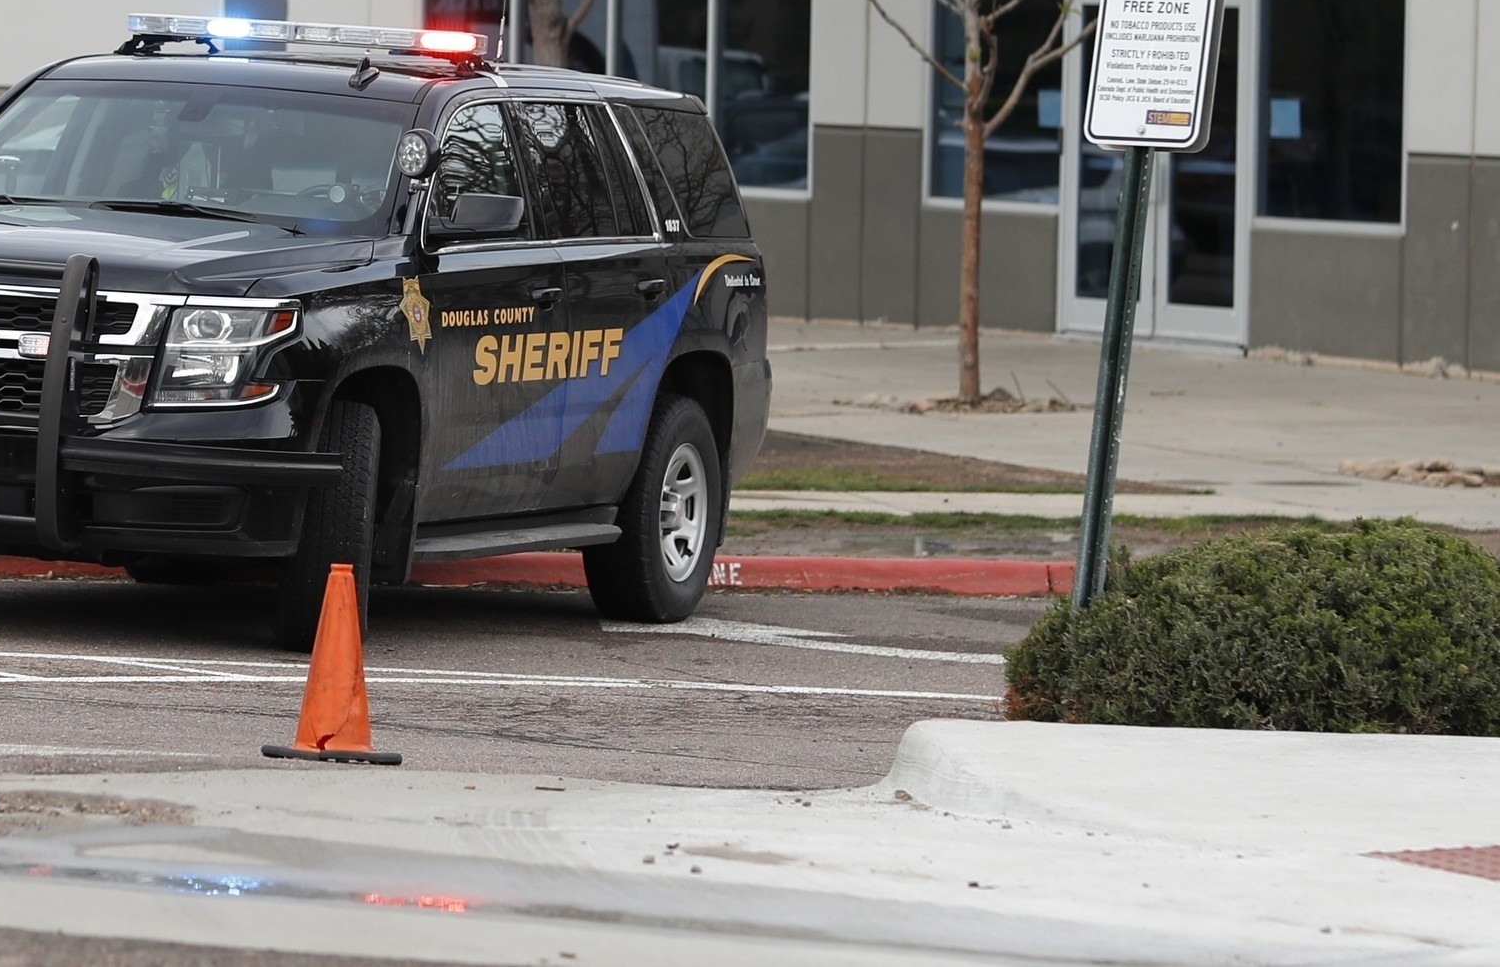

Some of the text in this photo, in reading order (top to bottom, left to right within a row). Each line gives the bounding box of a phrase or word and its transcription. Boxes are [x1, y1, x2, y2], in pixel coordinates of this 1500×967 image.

[1123, 0, 1190, 14] FREE ZONE
[1110, 20, 1196, 31] NO TOBACCO PRODUCTS USE
[1111, 49, 1190, 60] STRICTLY PROHIBITED
[1106, 61, 1192, 72] Violations Punishable by Fine
[441, 306, 535, 327] DOUGLAS COUNTY
[472, 328, 624, 385] SHERIFF
[707, 562, 742, 585] NE
